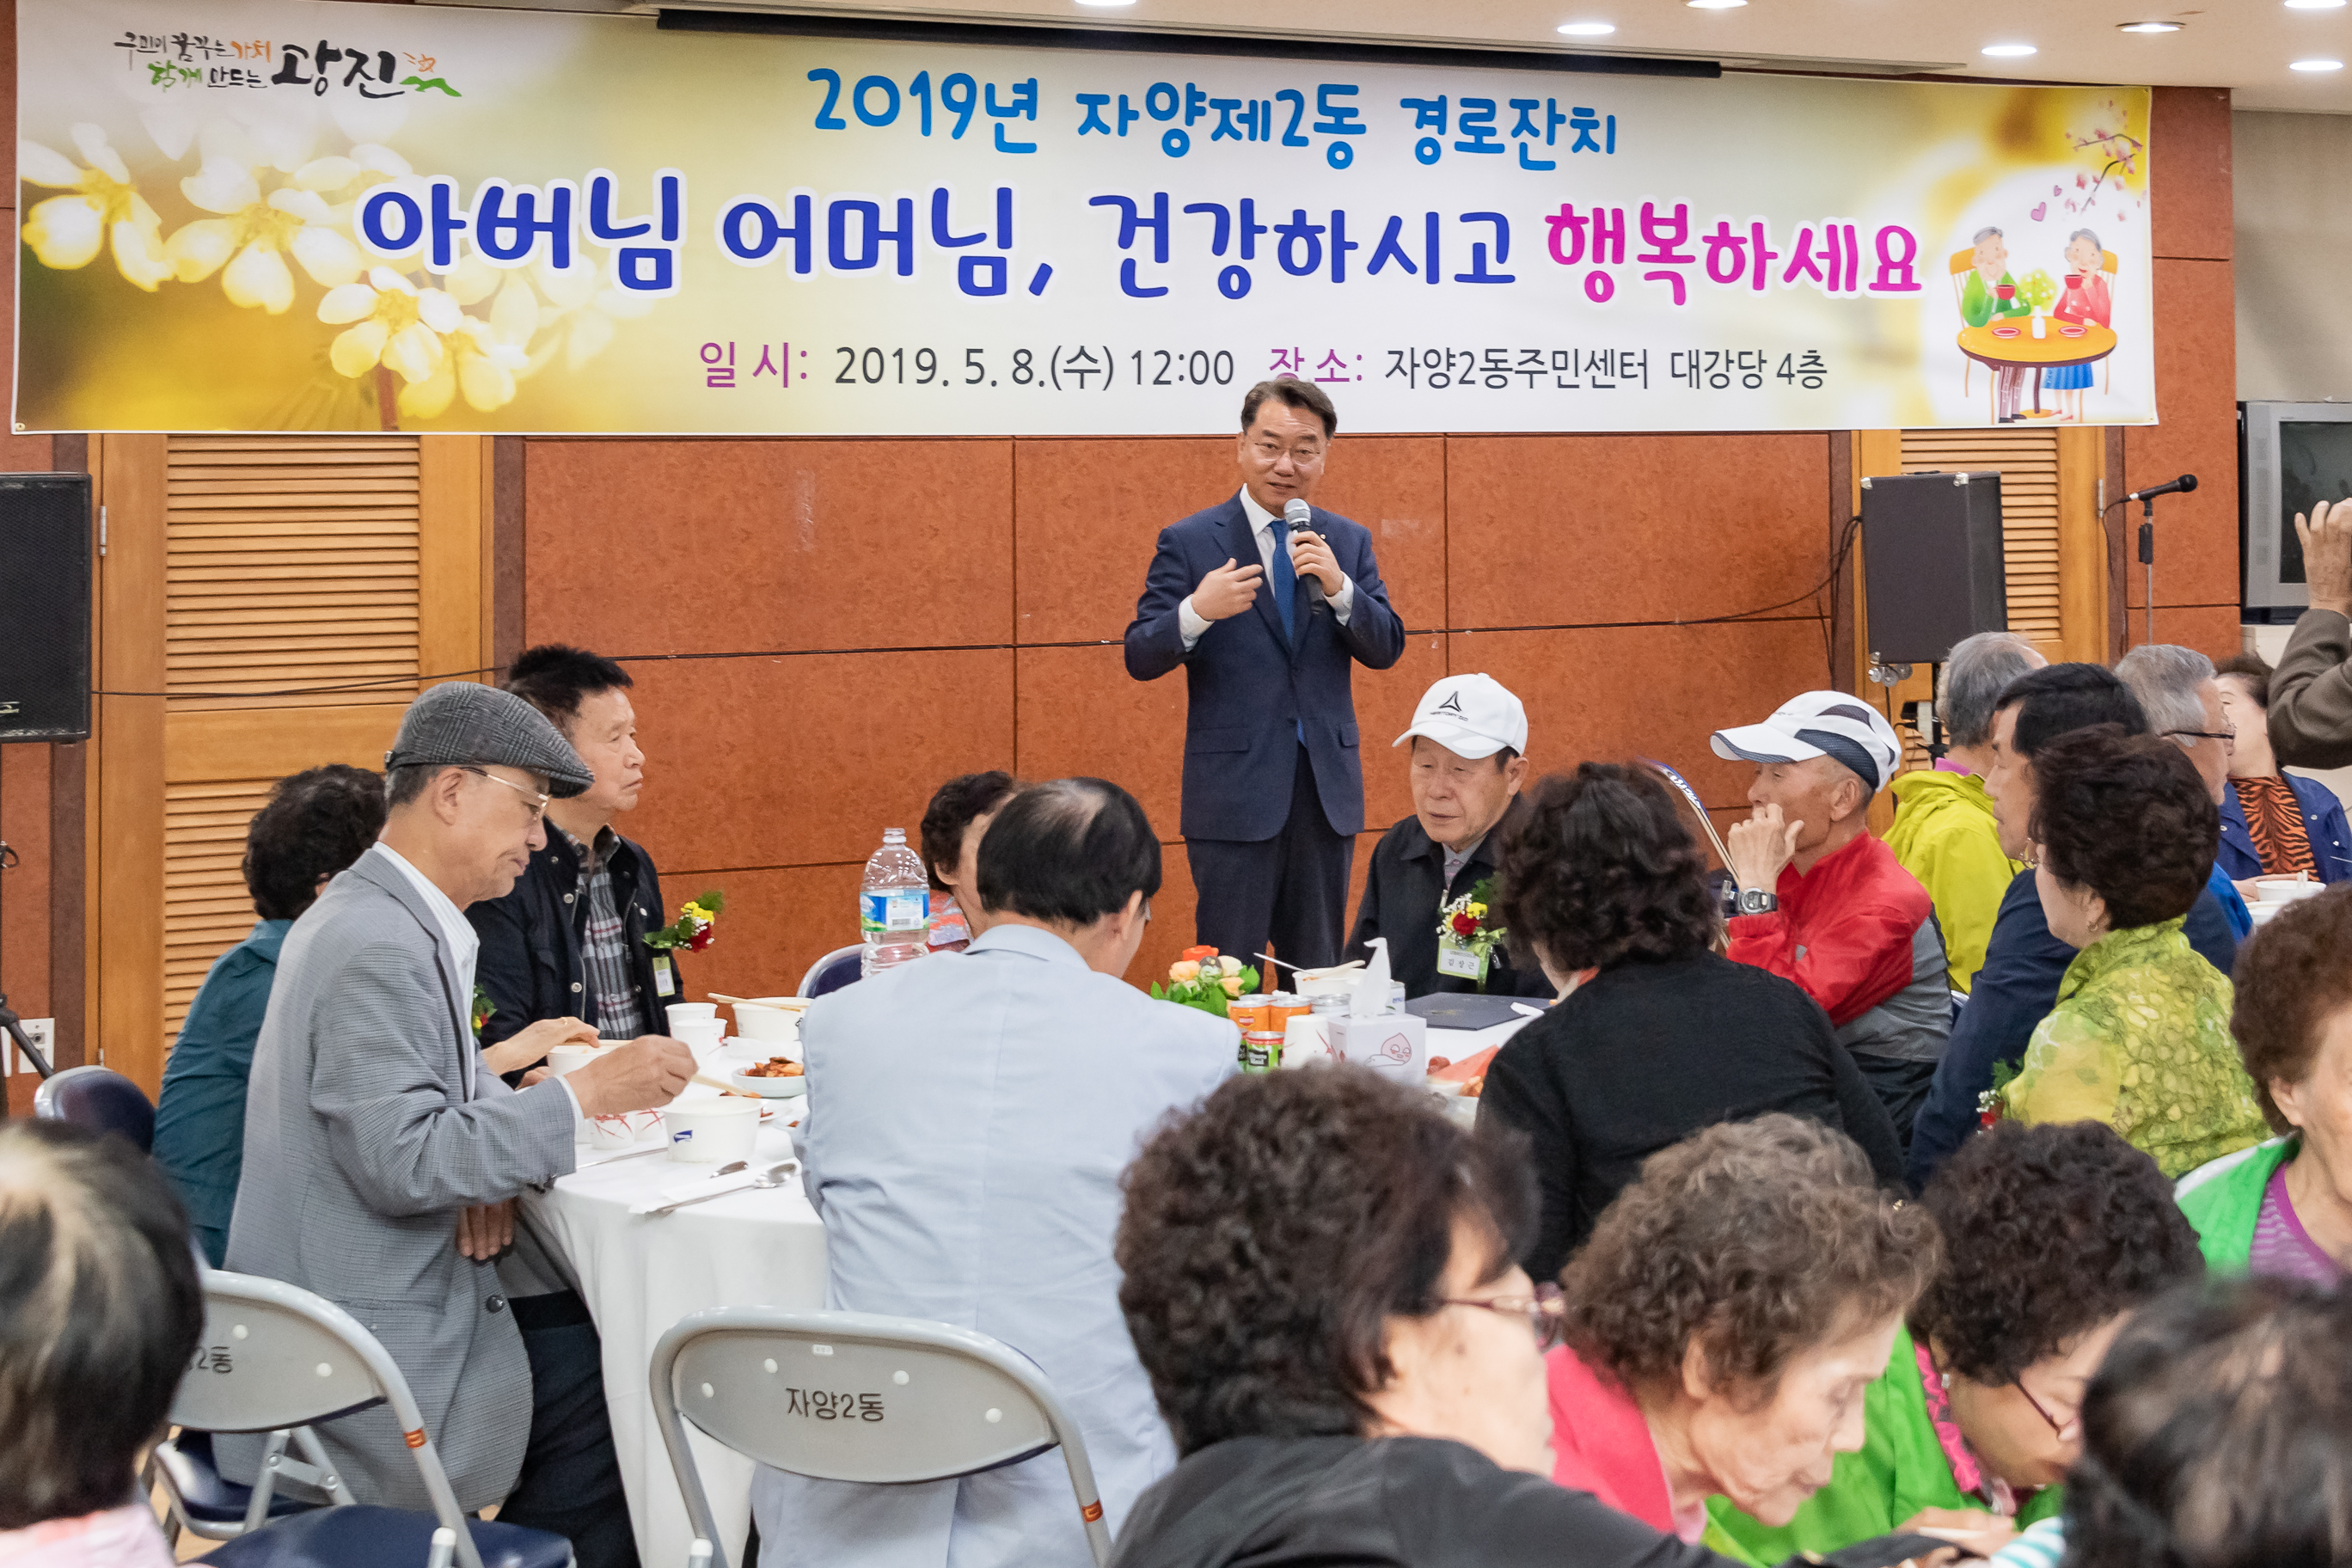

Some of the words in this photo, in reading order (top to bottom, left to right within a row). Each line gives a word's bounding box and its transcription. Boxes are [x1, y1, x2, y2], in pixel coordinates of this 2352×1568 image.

[271, 40, 406, 99] 광진
[807, 68, 1038, 155] 2019년
[1075, 82, 1369, 170] 자양제2동
[1400, 94, 1617, 172] 경로잔치
[363, 176, 680, 291] 아버님
[723, 187, 1053, 297] 어머님,
[1088, 192, 1516, 300] 건강하시고
[1544, 201, 1924, 306] 행복하세요
[1131, 350, 1234, 386] 12:00
[1385, 346, 1648, 390] 자양2동주민센터
[1670, 349, 1767, 390] 대강당
[1776, 349, 1828, 390] 4층
[785, 1387, 885, 1422] 자양2동
